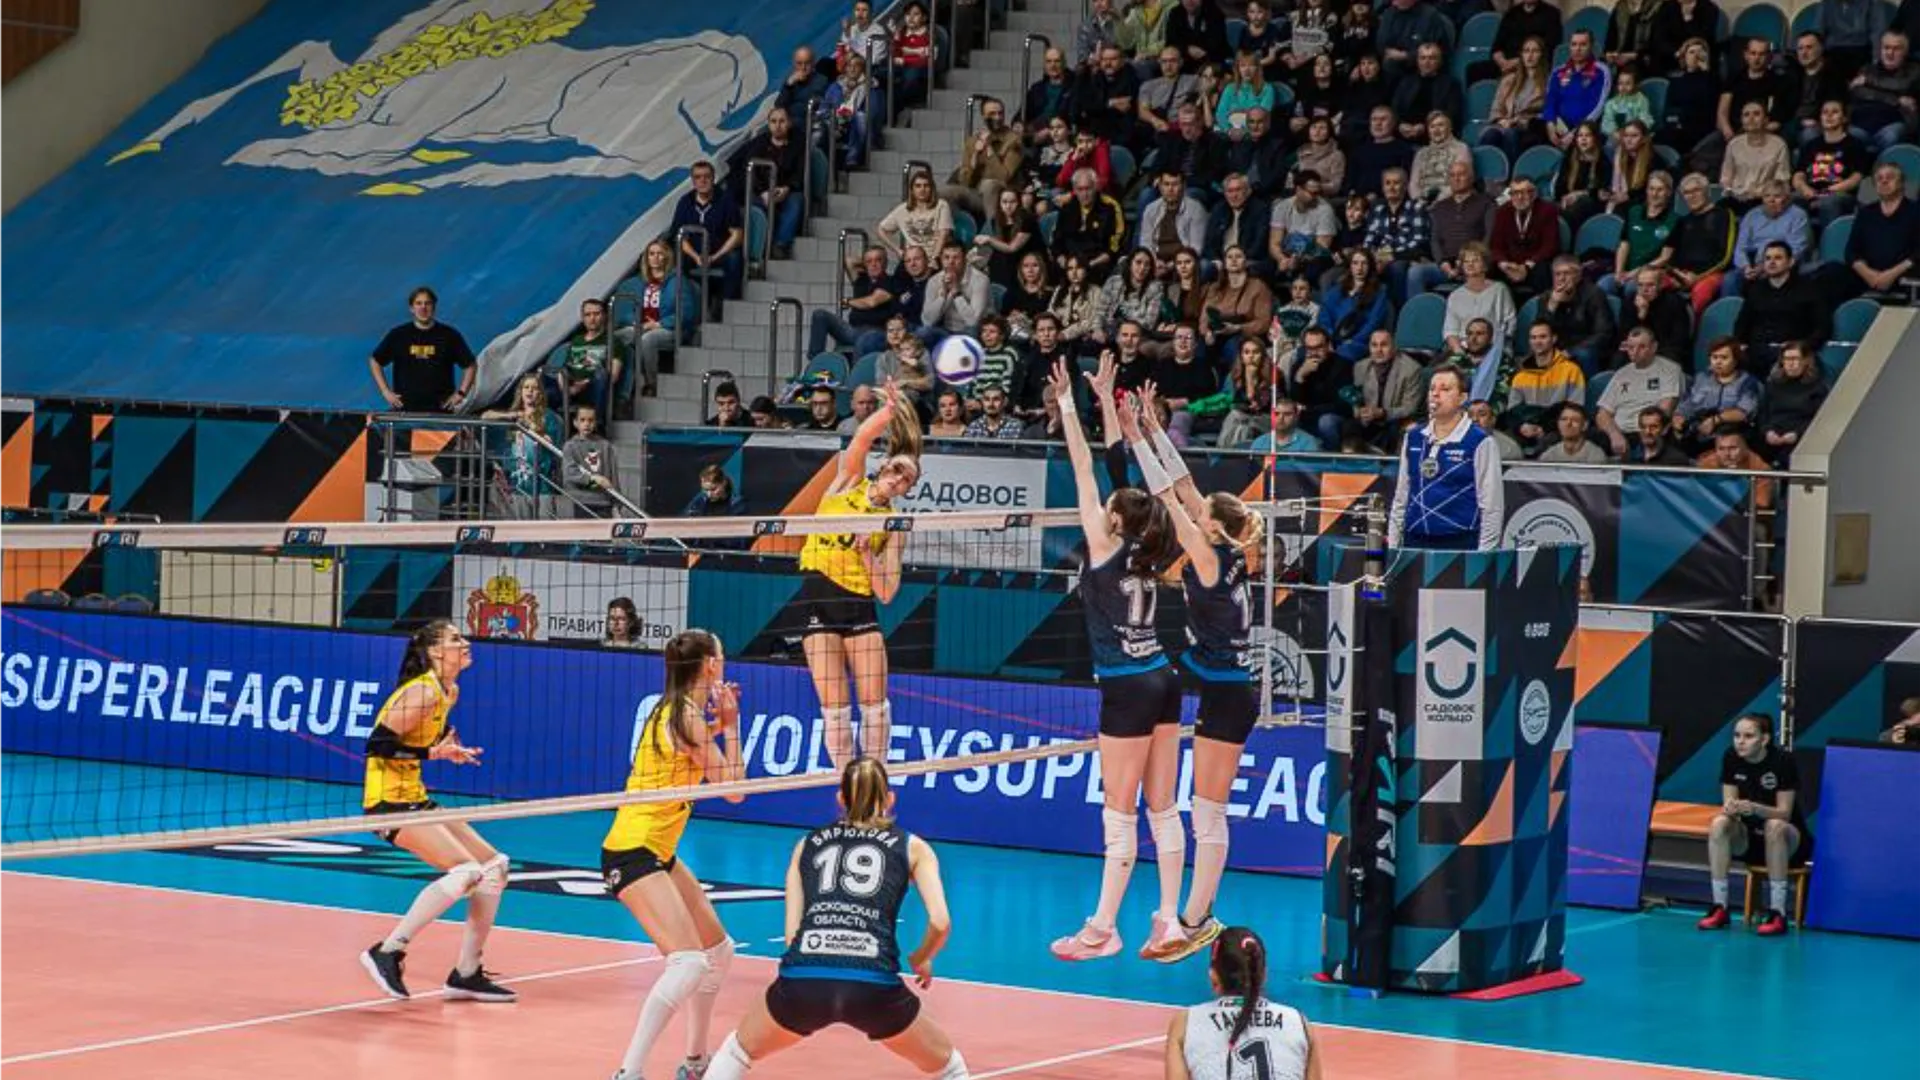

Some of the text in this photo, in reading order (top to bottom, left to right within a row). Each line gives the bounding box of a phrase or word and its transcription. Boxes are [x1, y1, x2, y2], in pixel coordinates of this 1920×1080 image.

[548, 616, 672, 639] ПРАВИТТВО
[0, 652, 380, 739] SUPERLEAGUE
[1424, 703, 1476, 713] САДОВОЕ
[1427, 714, 1473, 723] КОЛЬЦО
[813, 844, 887, 898] 19
